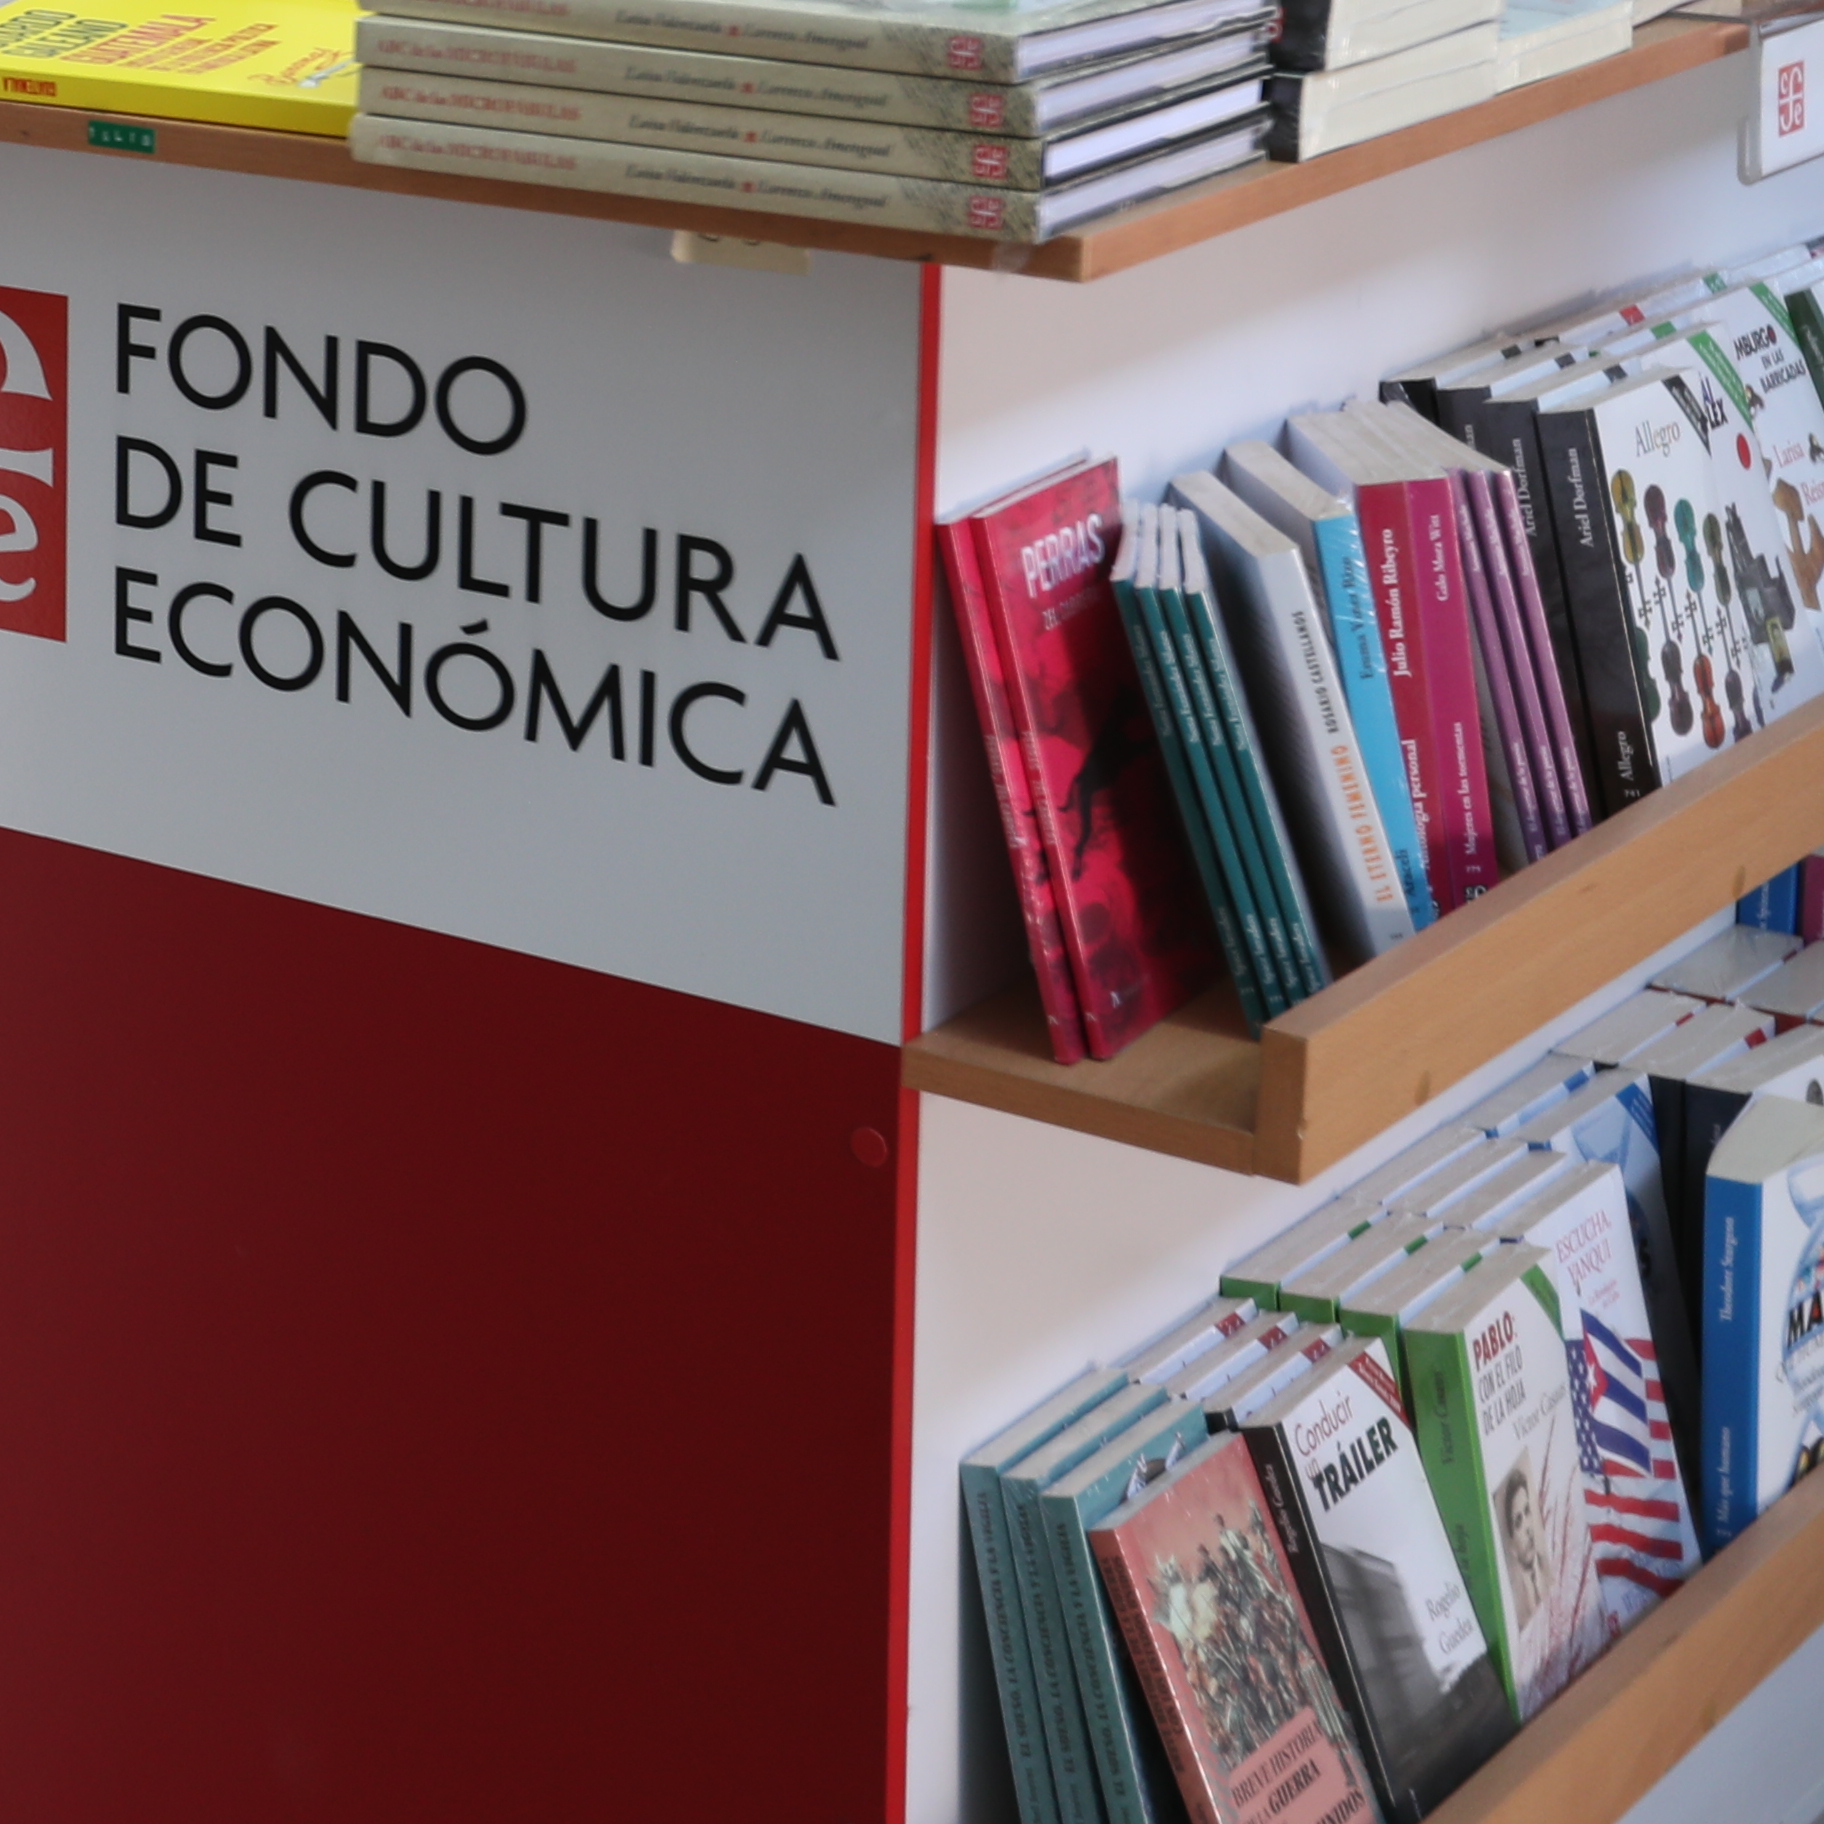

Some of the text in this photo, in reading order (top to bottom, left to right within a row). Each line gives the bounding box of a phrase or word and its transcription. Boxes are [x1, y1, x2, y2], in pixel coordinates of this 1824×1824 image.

[1, 17, 130, 61] GALEANO
[117, 302, 527, 456] FONDO
[1759, 358, 1808, 394] BARRICADAS
[1634, 420, 1681, 458] Allegro
[1772, 440, 1806, 470] Larisa
[1509, 437, 1538, 538] Ariel Dorfman
[116, 437, 840, 662] DE CULTURA
[1020, 512, 1106, 600] PERRAS
[1430, 542, 1446, 572] Mora
[1432, 573, 1450, 602] Galo
[1565, 446, 1637, 783] Allegro Ariel Dorfman
[115, 569, 837, 807] ECONÓMICA
[1380, 527, 1428, 799] personal Julio Ramón Ribeyro
[1291, 609, 1395, 902] EL ETERNO FEMENINO ROSARIO CASTELLANOS
[1451, 721, 1468, 777] tormentas
[1454, 777, 1470, 793] las
[1459, 794, 1472, 809] en
[1459, 810, 1478, 856] Mujeres
[1554, 1210, 1613, 1266] ESCUCHA,
[1472, 1310, 1518, 1373] PABLO:
[1478, 1344, 1524, 1404] CON EL FILO
[1293, 1391, 1355, 1458] Conducir
[1482, 1379, 1527, 1438] DE LA HOJA
[1312, 1415, 1399, 1514] TRÁILER
[1716, 1497, 1732, 1525] Más
[1425, 1581, 1463, 1623] Rogelio
[1438, 1616, 1476, 1656] Guedea
[1230, 1721, 1325, 1810] BREVE HISTORIA
[1268, 1758, 1322, 1817] GUERRA
